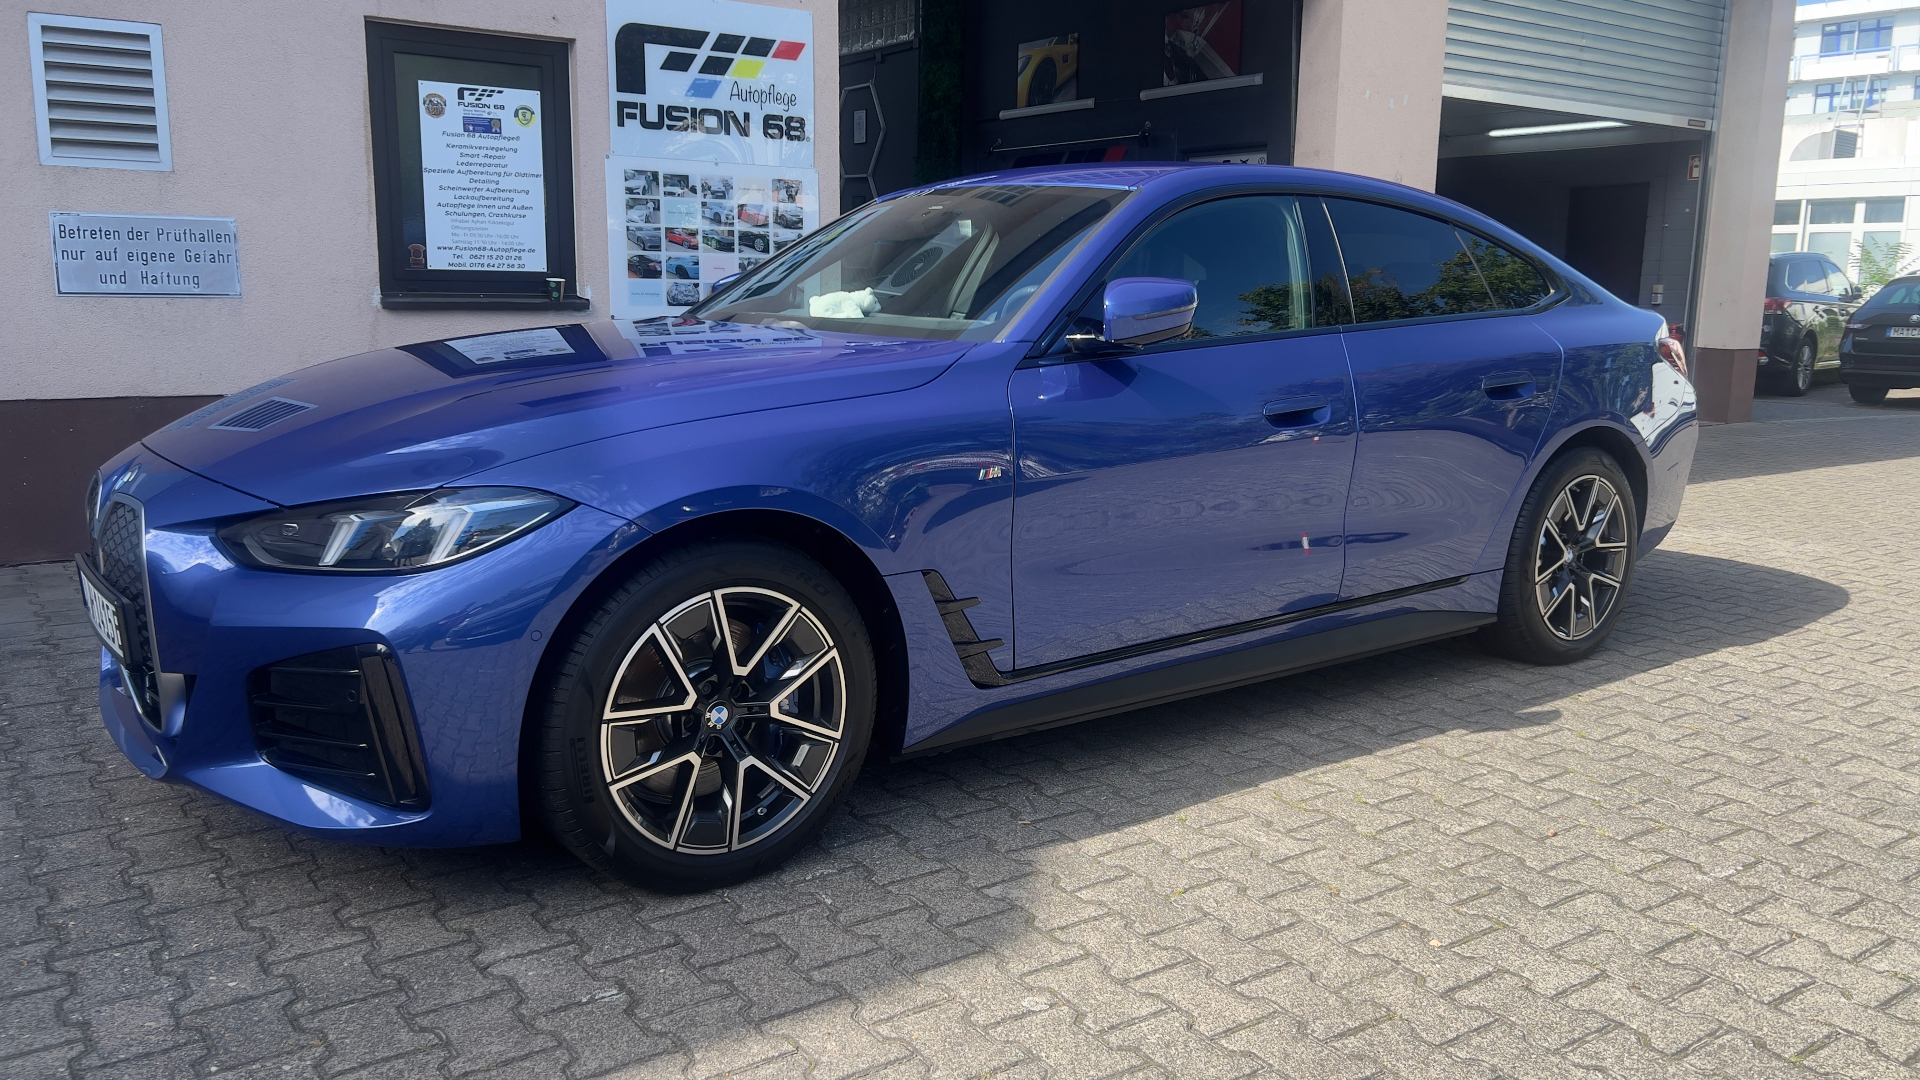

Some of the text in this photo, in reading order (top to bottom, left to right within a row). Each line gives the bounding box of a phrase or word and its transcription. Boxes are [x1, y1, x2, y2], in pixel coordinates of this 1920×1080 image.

[729, 80, 797, 112] Autopflege
[616, 100, 750, 137] FUSION
[442, 130, 465, 138] Fusion
[446, 143, 518, 154] Keramikversiegelung
[456, 161, 509, 169] Lederreparatur
[423, 167, 455, 175] Spezielle
[456, 169, 502, 178] Aufbereitung
[514, 171, 542, 179] Oldtimer
[469, 177, 500, 186] Detailing
[438, 185, 530, 195] Scheinwerfer Aufbereitung
[453, 194, 515, 203] Lackaufbereitung
[436, 202, 476, 210] Autopflege
[488, 211, 527, 219] Crashkurse
[58, 223, 232, 244] Betreten der Prüfhallen
[436, 245, 536, 254] www.Fusion68-Autopflege.de
[61, 247, 232, 266] nur auf eigene Gefahr
[99, 270, 200, 289] und Haftung
